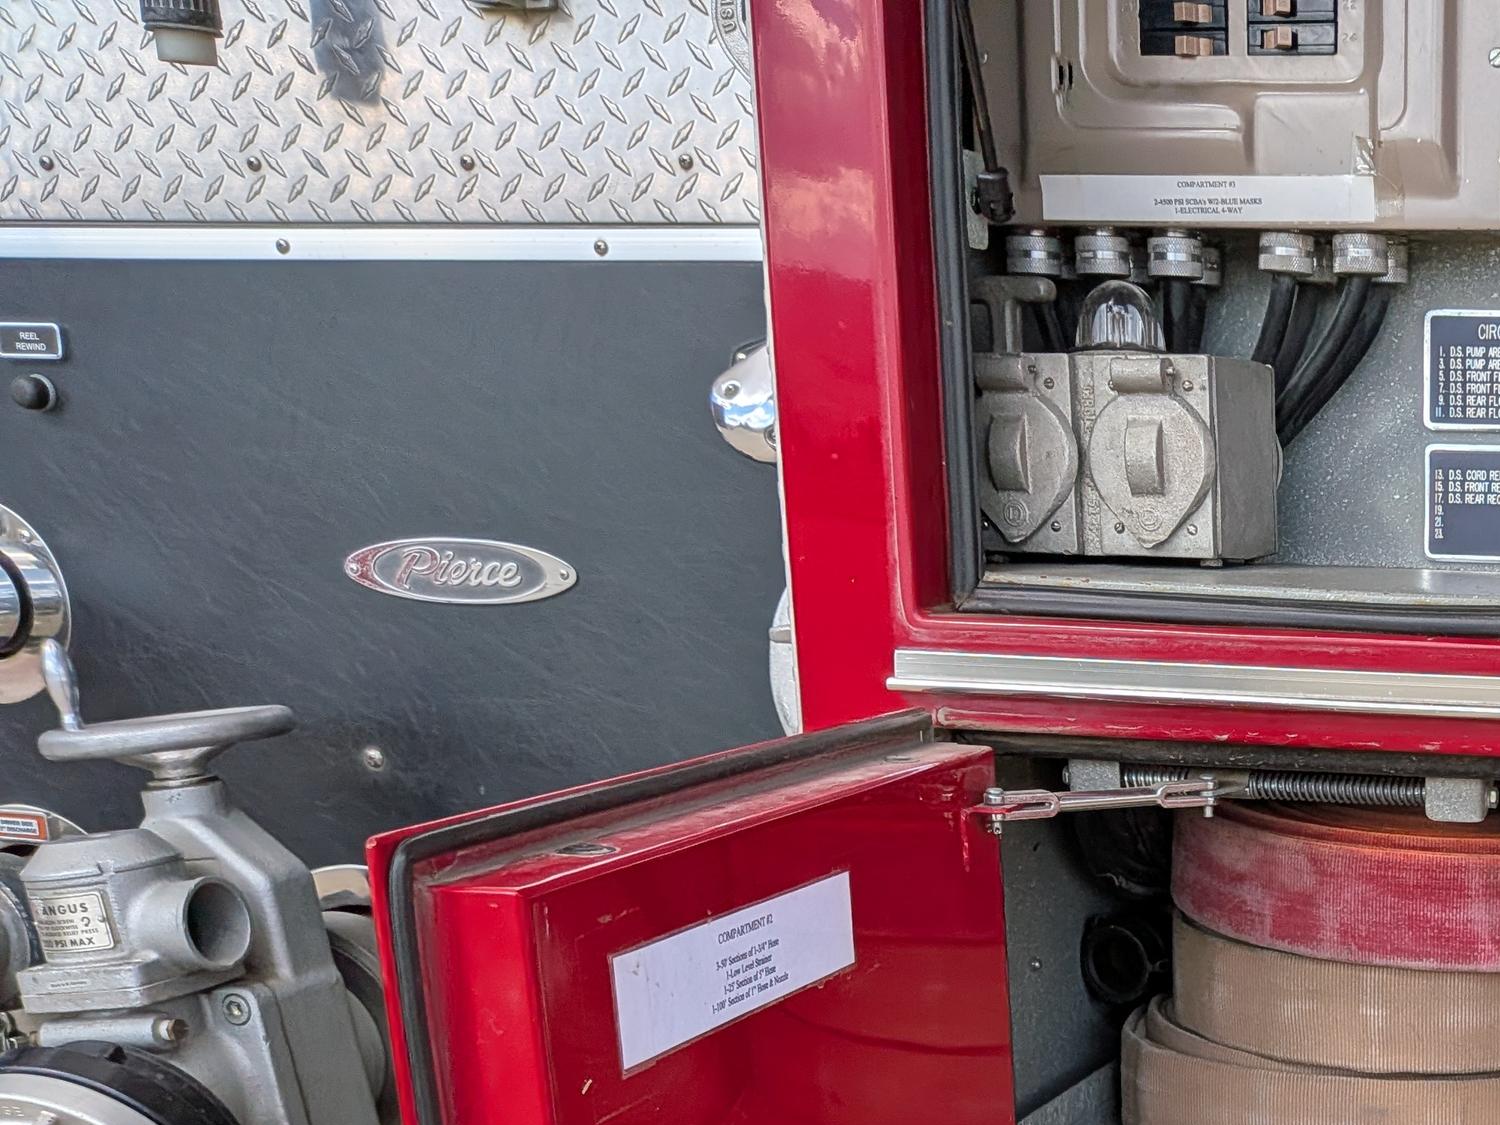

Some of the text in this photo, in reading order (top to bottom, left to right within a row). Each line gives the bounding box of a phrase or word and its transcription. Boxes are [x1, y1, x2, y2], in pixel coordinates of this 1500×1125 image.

[19, 331, 40, 340] REEL
[16, 342, 47, 351] REWIND
[1450, 346, 1464, 357] D.S.
[1466, 346, 1486, 357] PUMP
[1450, 358, 1464, 369] D.S.
[1466, 358, 1486, 369] PUMP
[1450, 370, 1464, 381] D.S.
[1466, 371, 1491, 382] FRONT
[1450, 382, 1464, 393] D.S.
[1466, 383, 1491, 394] FRONT
[1449, 395, 1463, 406] D.S.
[1466, 395, 1487, 406] REAR
[1449, 407, 1463, 417] D.S.
[1466, 408, 1487, 418] REAR
[1448, 469, 1463, 480] D.S.
[1466, 470, 1487, 481] CORD
[1448, 481, 1462, 492] D.S.
[1464, 482, 1489, 493] FRONT
[1448, 493, 1462, 504] D.S.
[1464, 493, 1485, 504] REAR
[396, 546, 522, 589] Pierce
[42, 902, 89, 916] ANGUS
[718, 916, 766, 944] COMPARTMENT
[70, 937, 95, 947] MAX
